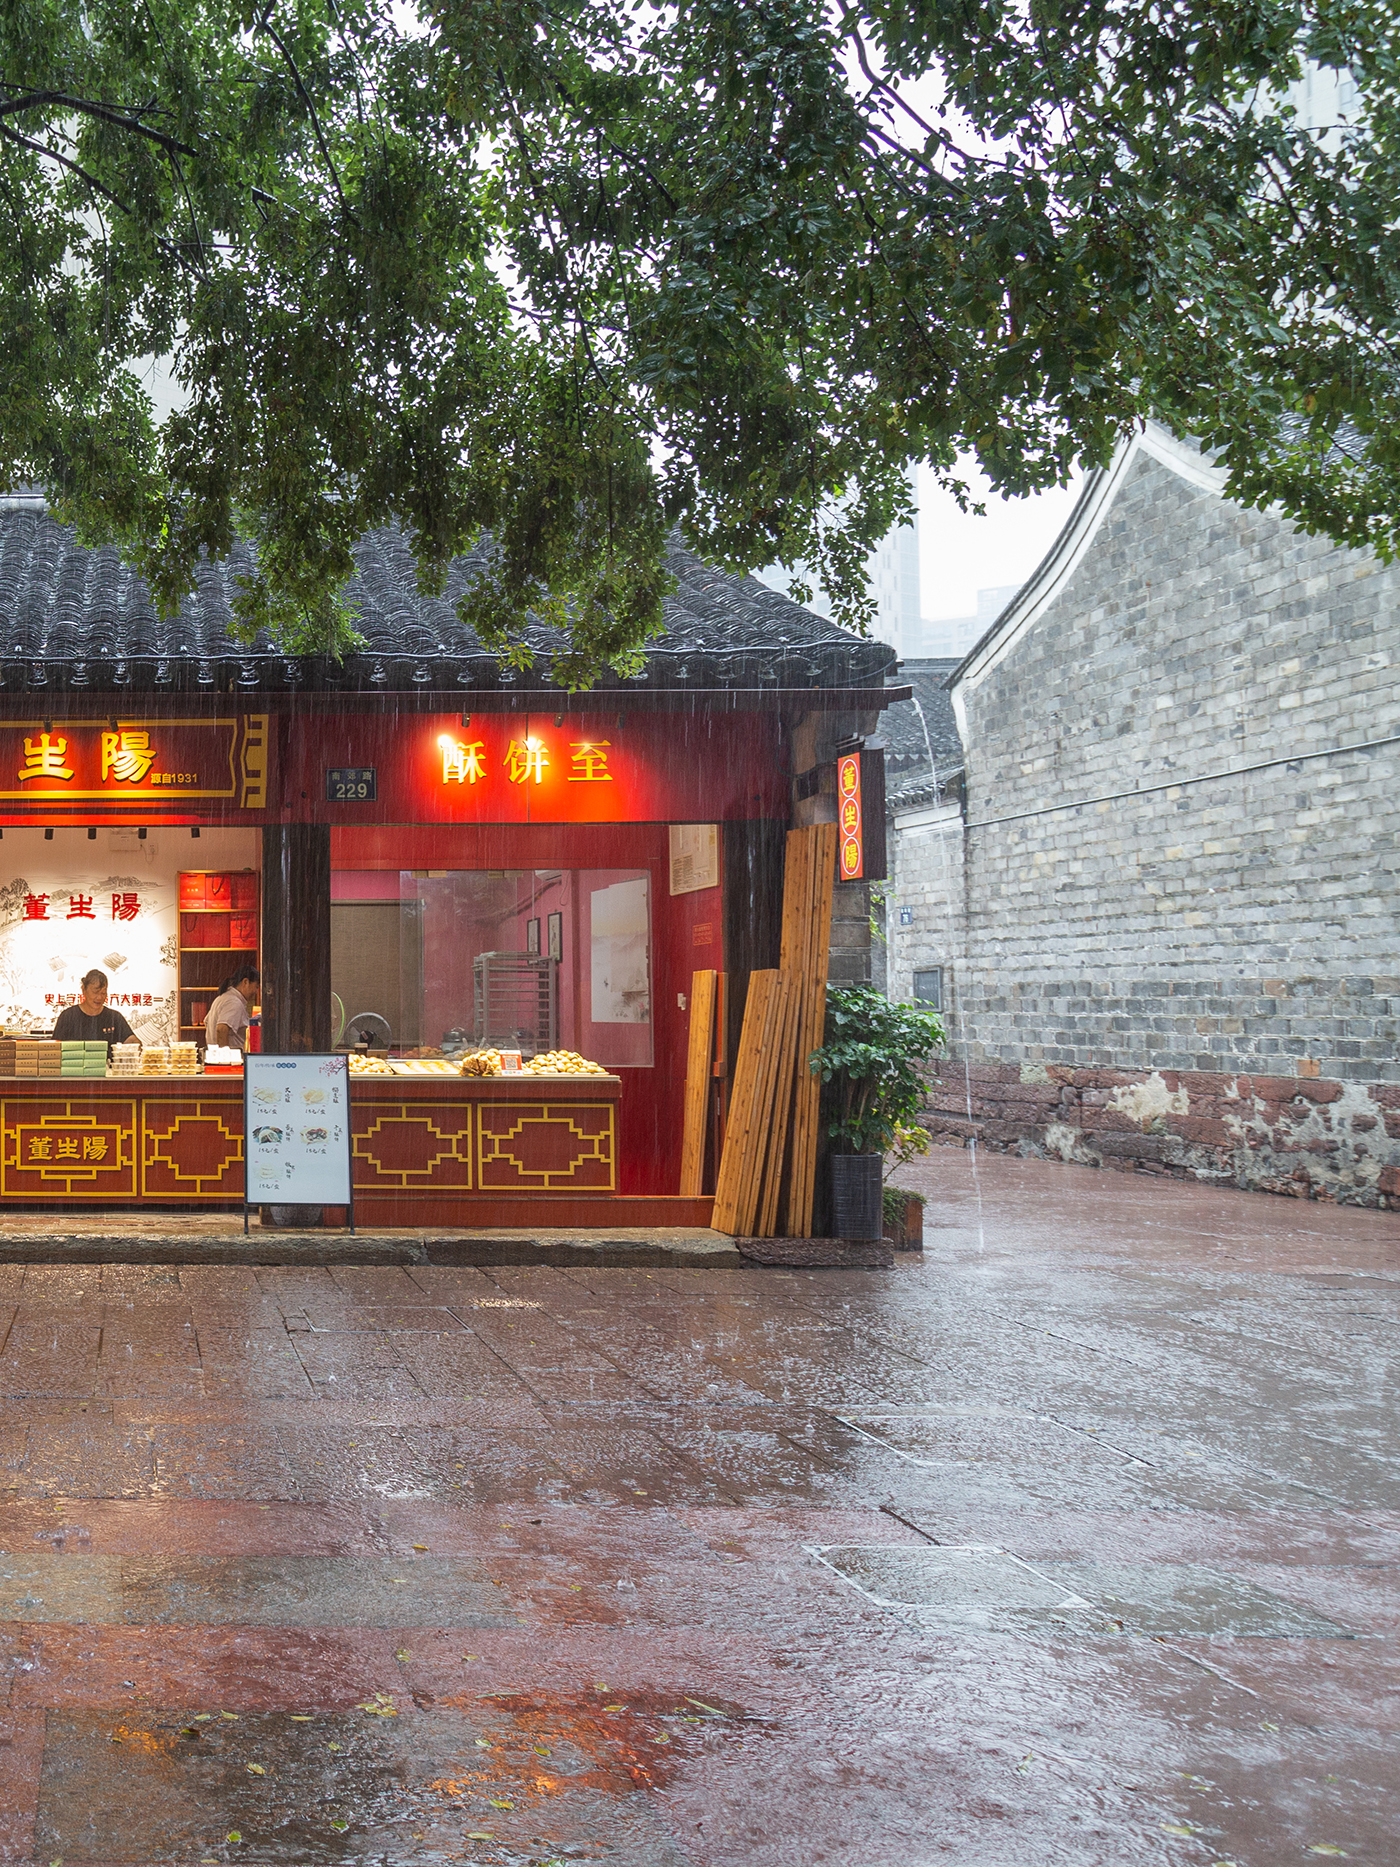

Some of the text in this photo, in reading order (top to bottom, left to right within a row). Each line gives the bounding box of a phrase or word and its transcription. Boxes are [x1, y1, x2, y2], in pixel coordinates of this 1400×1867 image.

[441, 740, 612, 784] 酥饼至
[151, 773, 197, 784] 源自1931
[336, 783, 367, 798] 229
[843, 765, 858, 868] 董生陽
[22, 893, 141, 921] 董生陽
[28, 1136, 109, 1160] 董生陽
